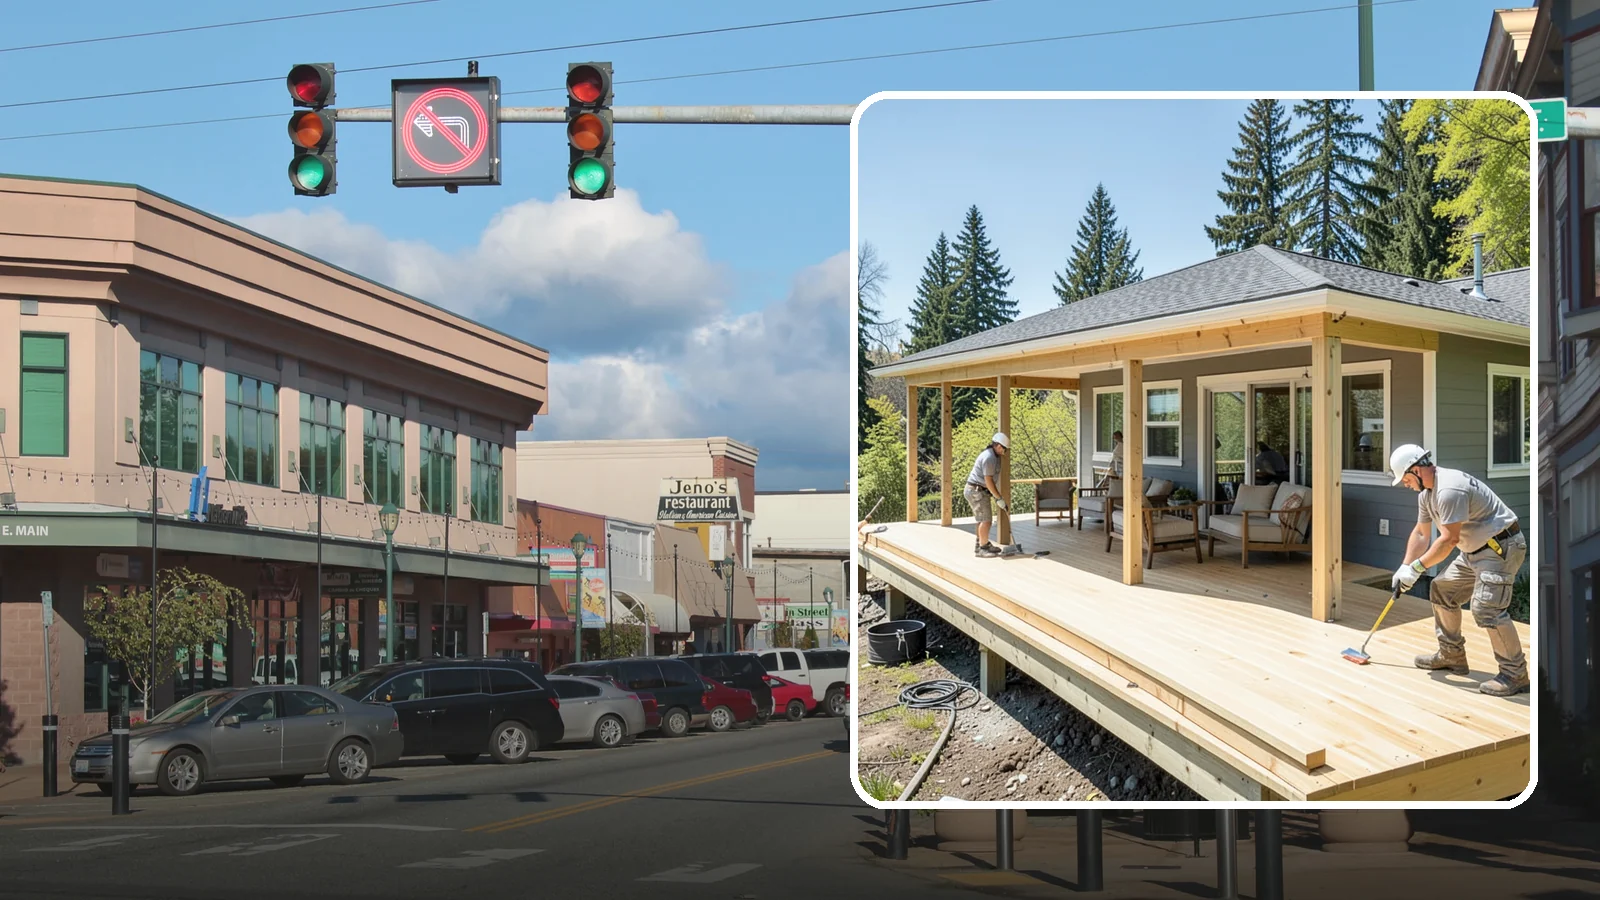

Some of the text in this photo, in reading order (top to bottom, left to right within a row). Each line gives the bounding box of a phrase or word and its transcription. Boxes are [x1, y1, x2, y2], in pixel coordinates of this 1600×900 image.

[670, 480, 727, 494] Jeno's
[665, 496, 731, 509] restaurant
[686, 510, 715, 519] American
[714, 509, 738, 519] Cuisine
[2, 525, 49, 536] E. MAIN
[797, 607, 829, 617] Street
